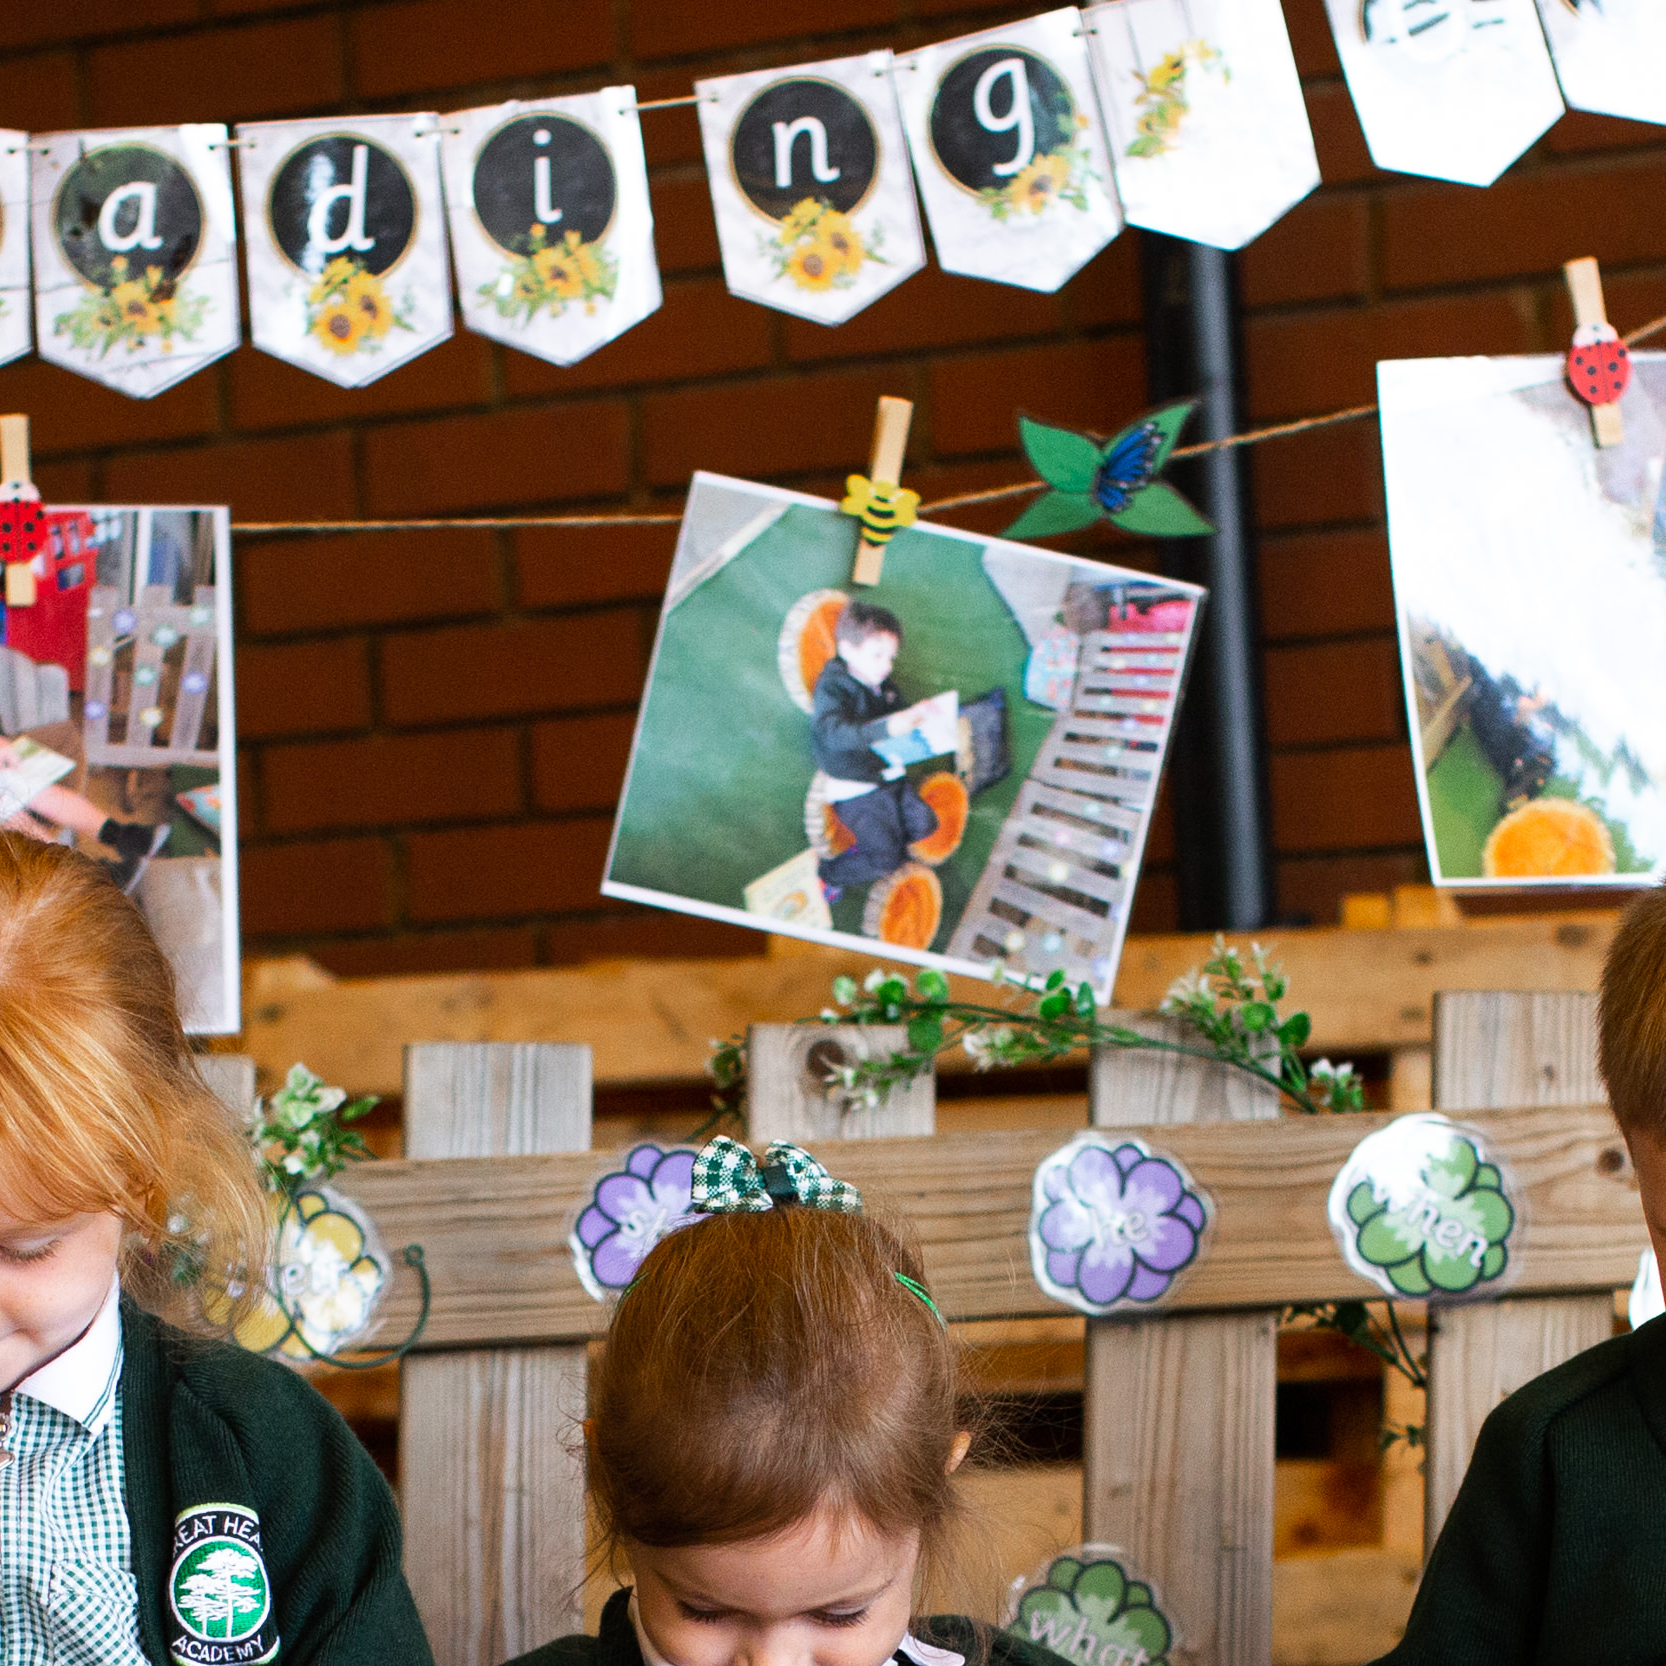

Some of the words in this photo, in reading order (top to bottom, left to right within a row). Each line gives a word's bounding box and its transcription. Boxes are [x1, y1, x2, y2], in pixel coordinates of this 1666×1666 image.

[173, 1515, 217, 1556] EAT
[223, 1515, 264, 1552] HEA
[171, 1634, 265, 1663] ACADEMY
